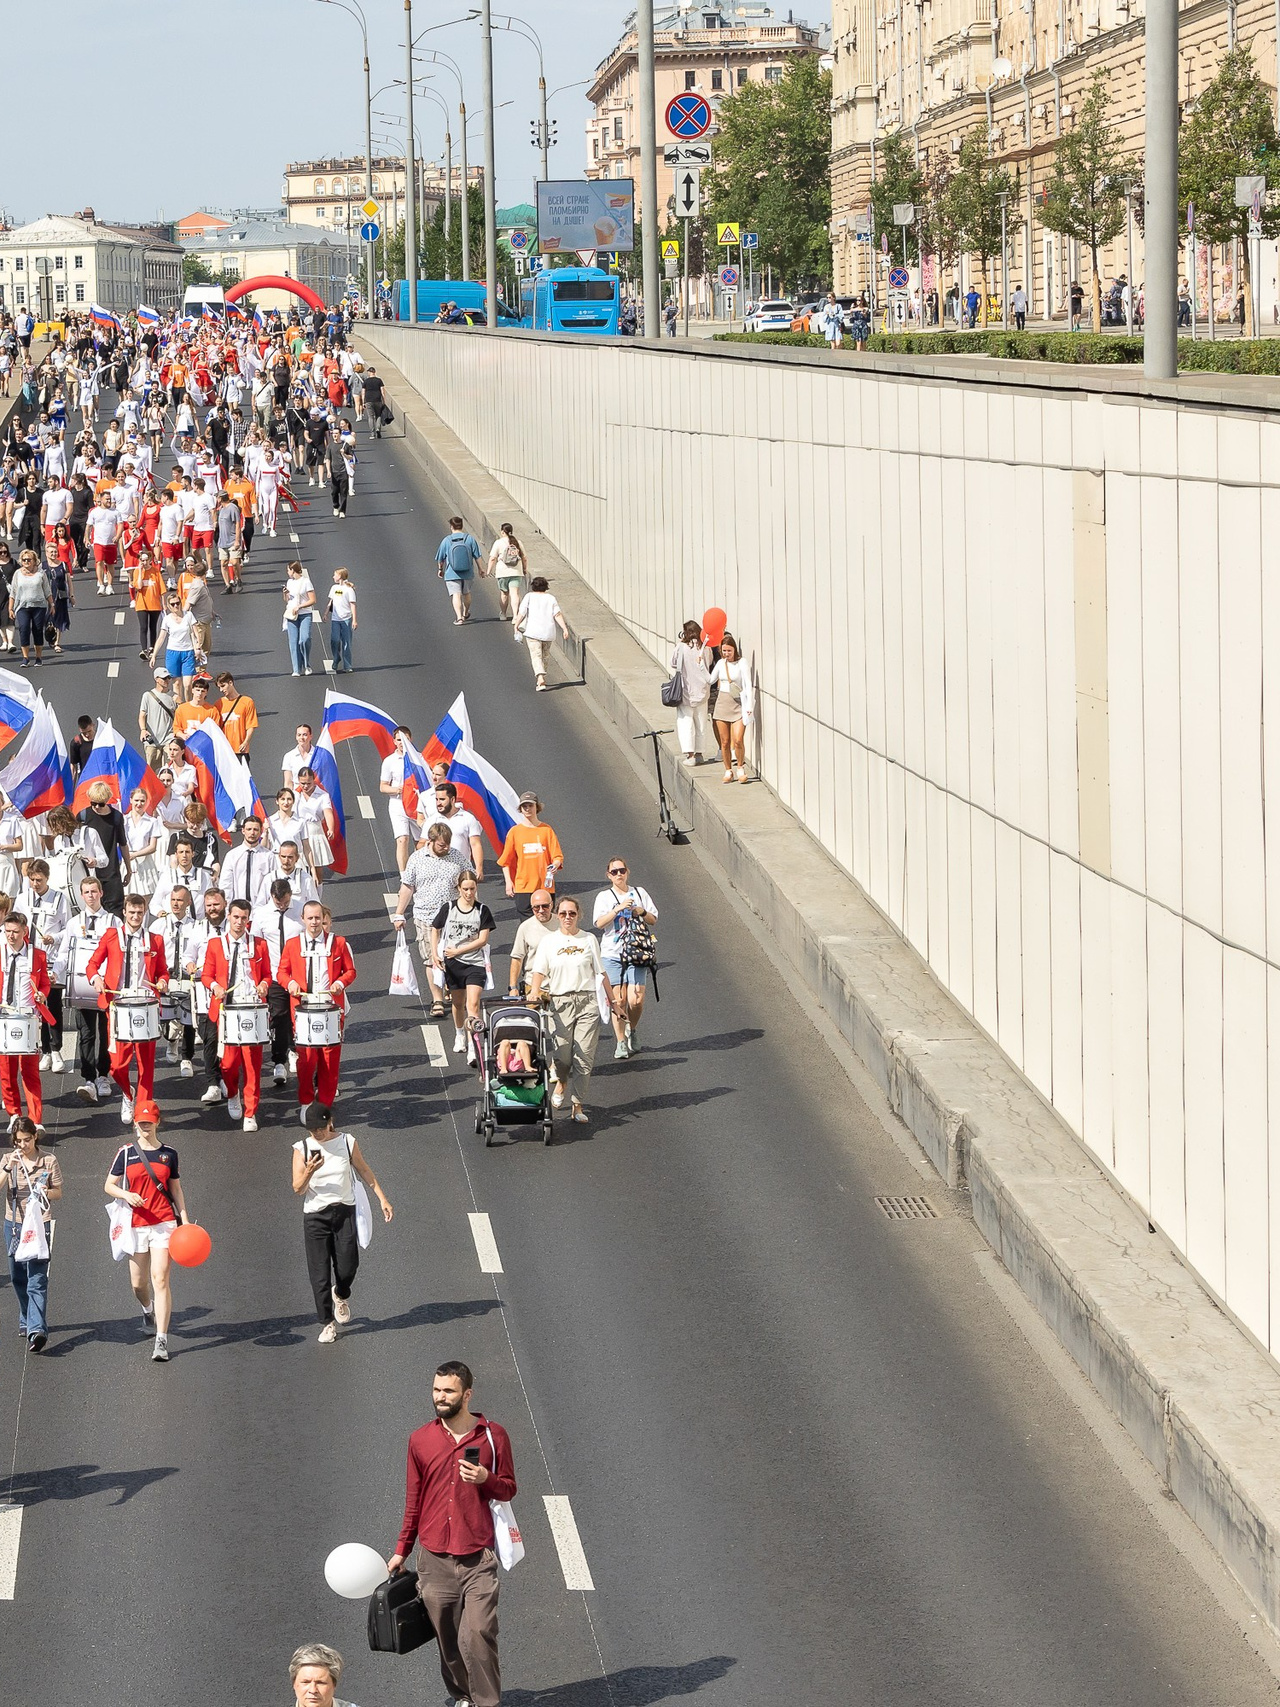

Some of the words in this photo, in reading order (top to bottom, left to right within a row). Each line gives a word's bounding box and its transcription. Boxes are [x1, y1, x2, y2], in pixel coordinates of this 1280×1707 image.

[548, 195, 564, 205] ВСЕЙ
[567, 195, 590, 204] СТРАНЕ
[549, 205, 589, 215] ПЛОМБИРНО
[552, 216, 560, 225] НА
[563, 216, 585, 226] ДУШЕ!
